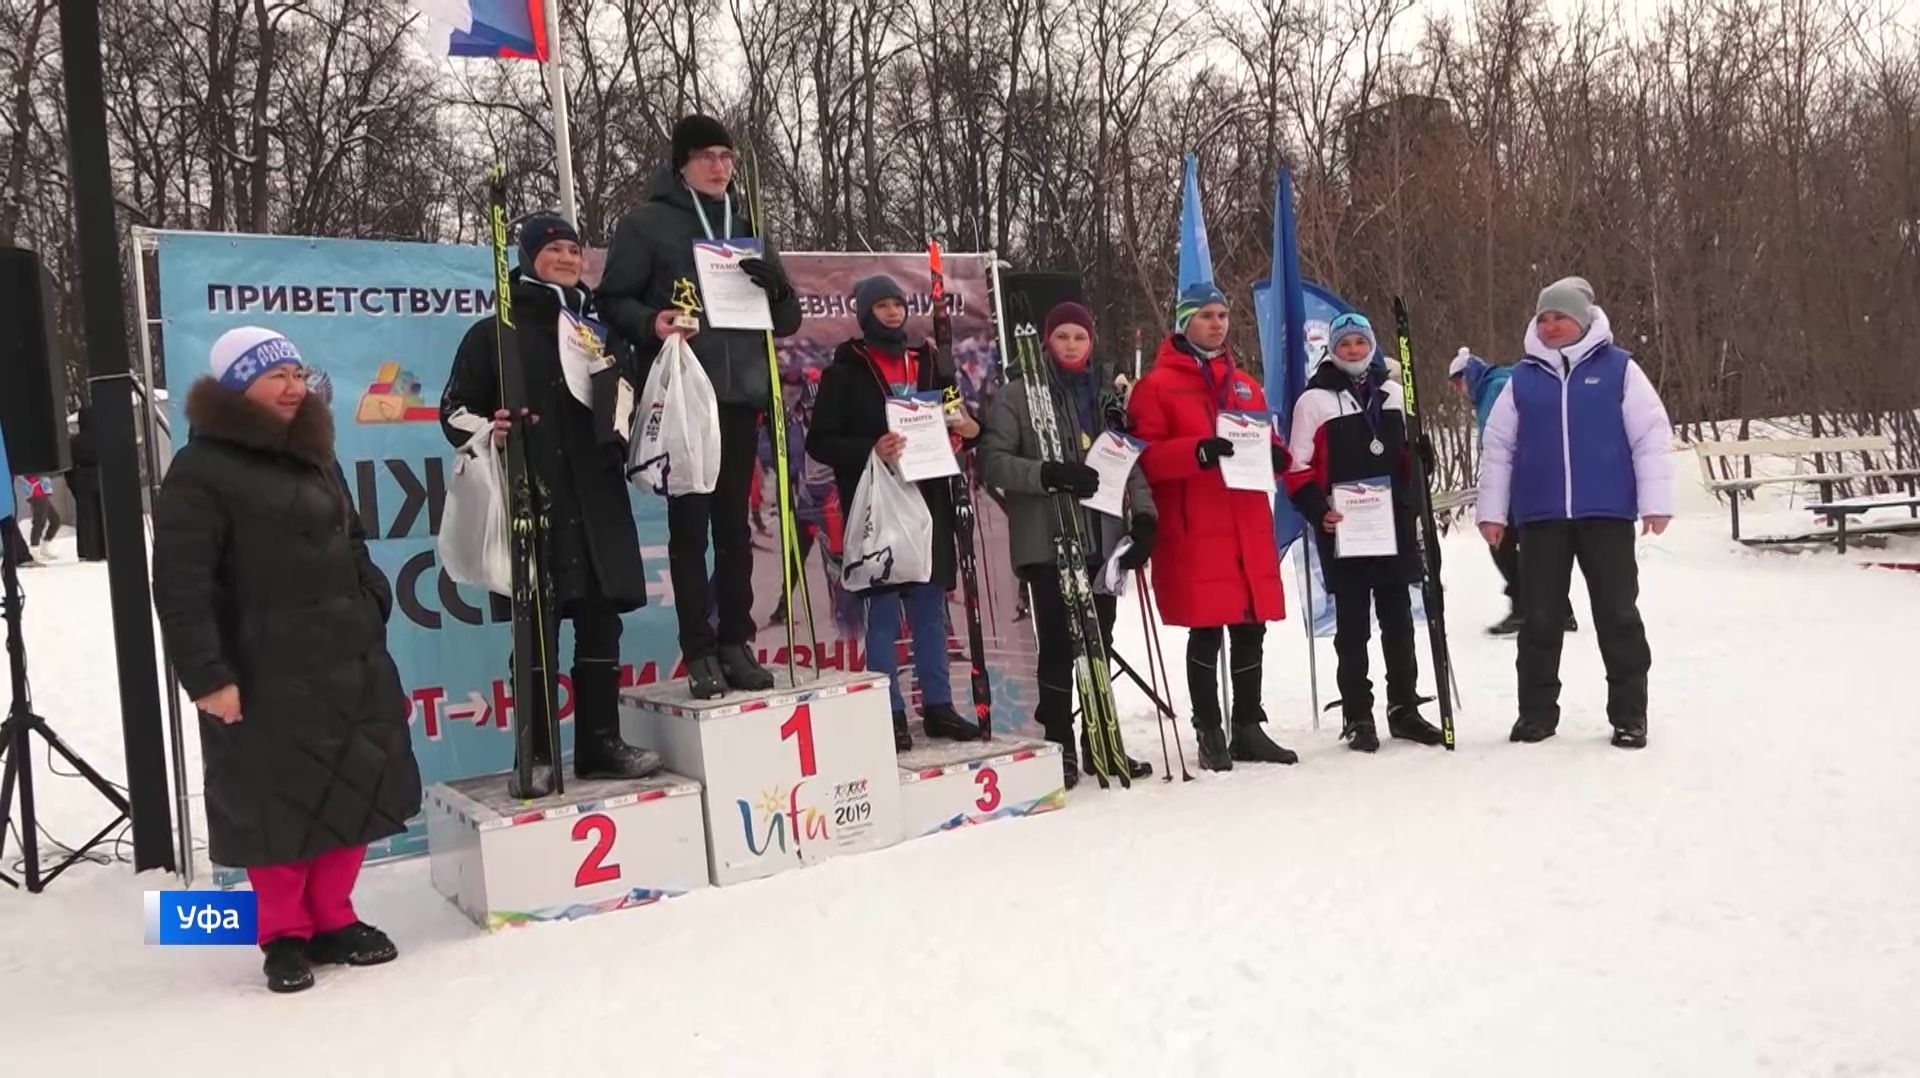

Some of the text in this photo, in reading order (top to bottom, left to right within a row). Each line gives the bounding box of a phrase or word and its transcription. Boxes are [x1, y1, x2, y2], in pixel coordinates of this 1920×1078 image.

[494, 205, 516, 328] FISCHER
[710, 262, 740, 271] ГРАМО
[206, 283, 496, 315] ПРИВЕТСТВУЕМ
[1398, 336, 1417, 416] FISCHER
[899, 414, 934, 425] ГРАМОТА
[780, 703, 817, 778] 1
[974, 767, 1001, 812] 3
[834, 801, 872, 826] 2019
[571, 813, 621, 888] 2
